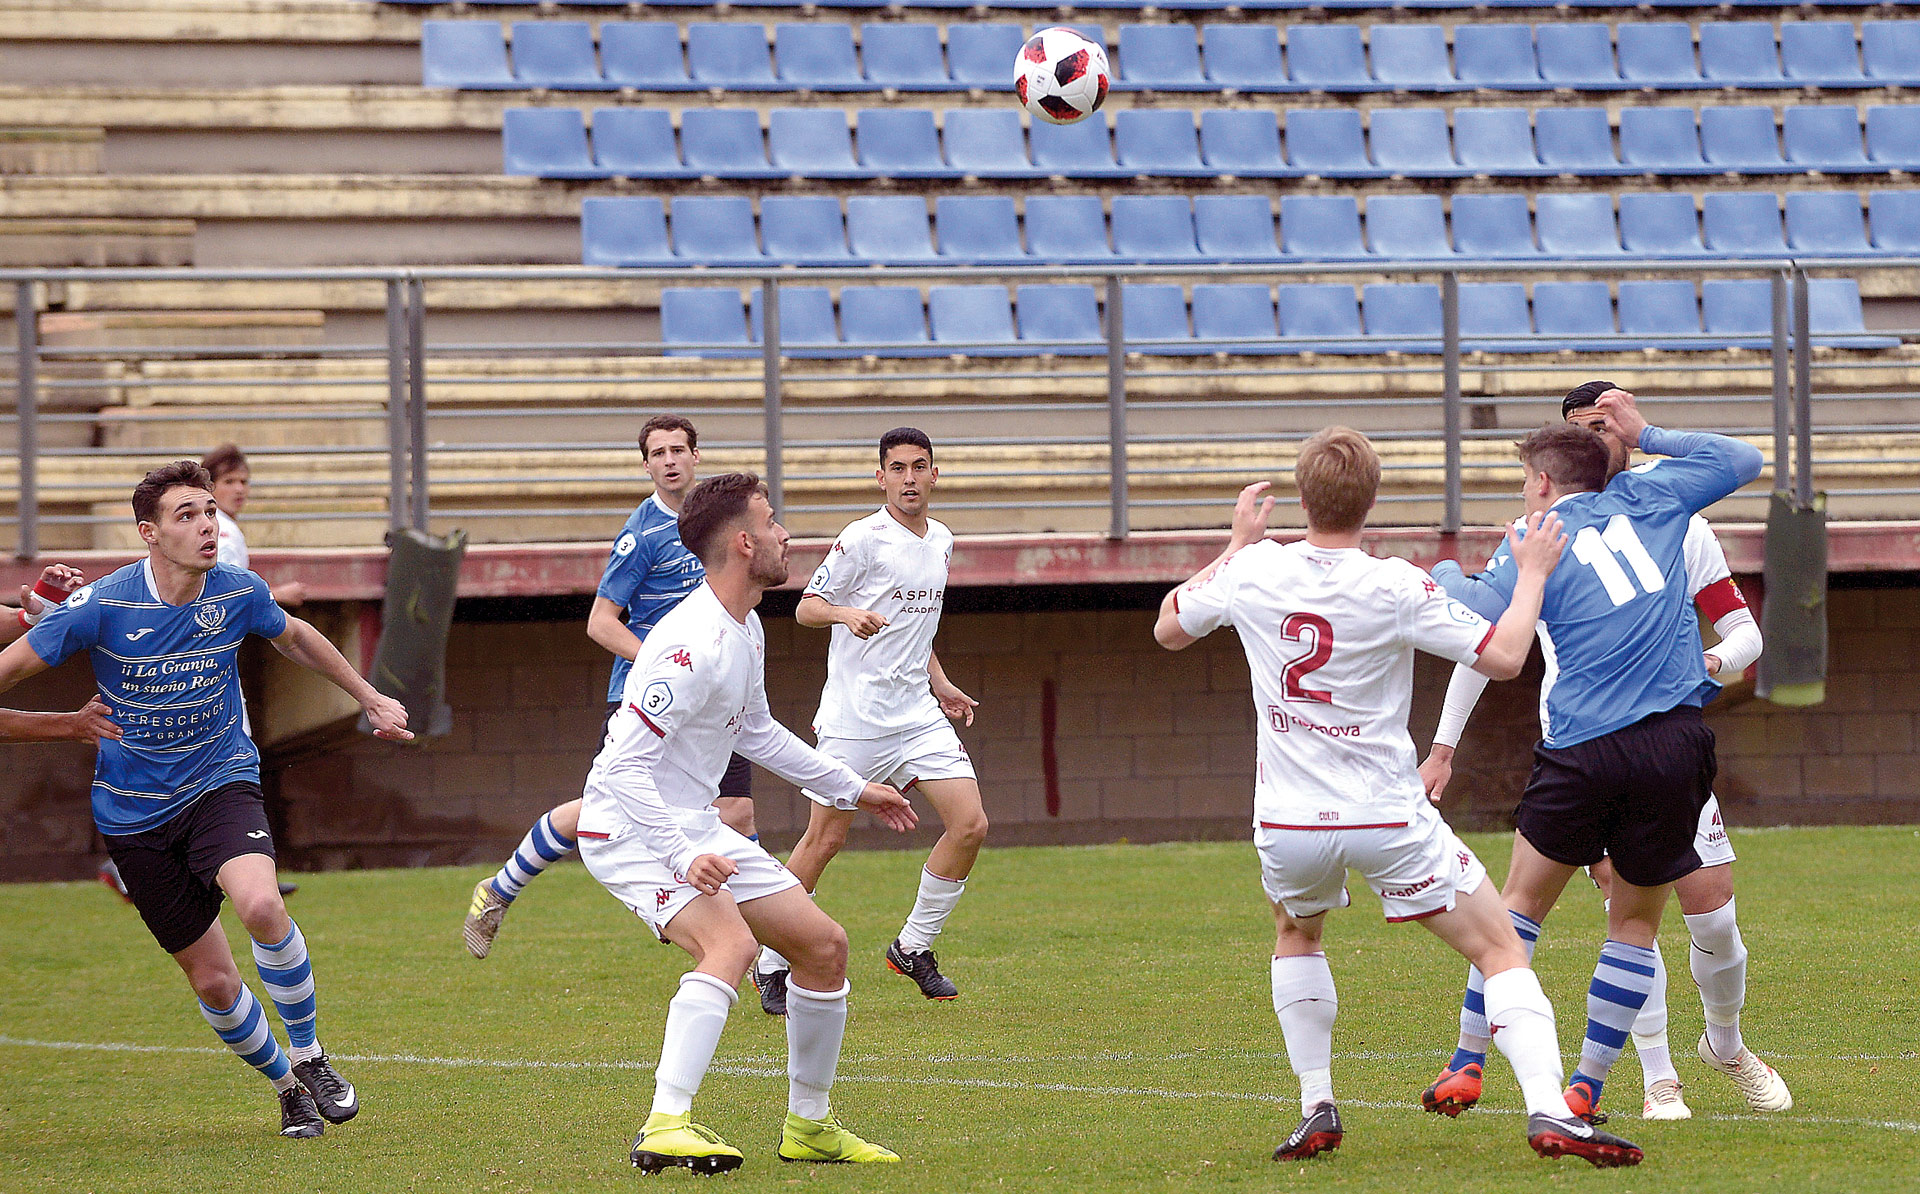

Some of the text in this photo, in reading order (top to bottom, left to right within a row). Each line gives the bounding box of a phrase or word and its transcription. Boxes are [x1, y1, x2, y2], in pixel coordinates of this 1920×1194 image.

[1571, 514, 1665, 607] 11
[121, 681, 140, 692] un
[143, 680, 187, 693] sueño
[134, 664, 158, 678] La
[161, 656, 219, 675] Granja,
[1280, 612, 1334, 704] 2
